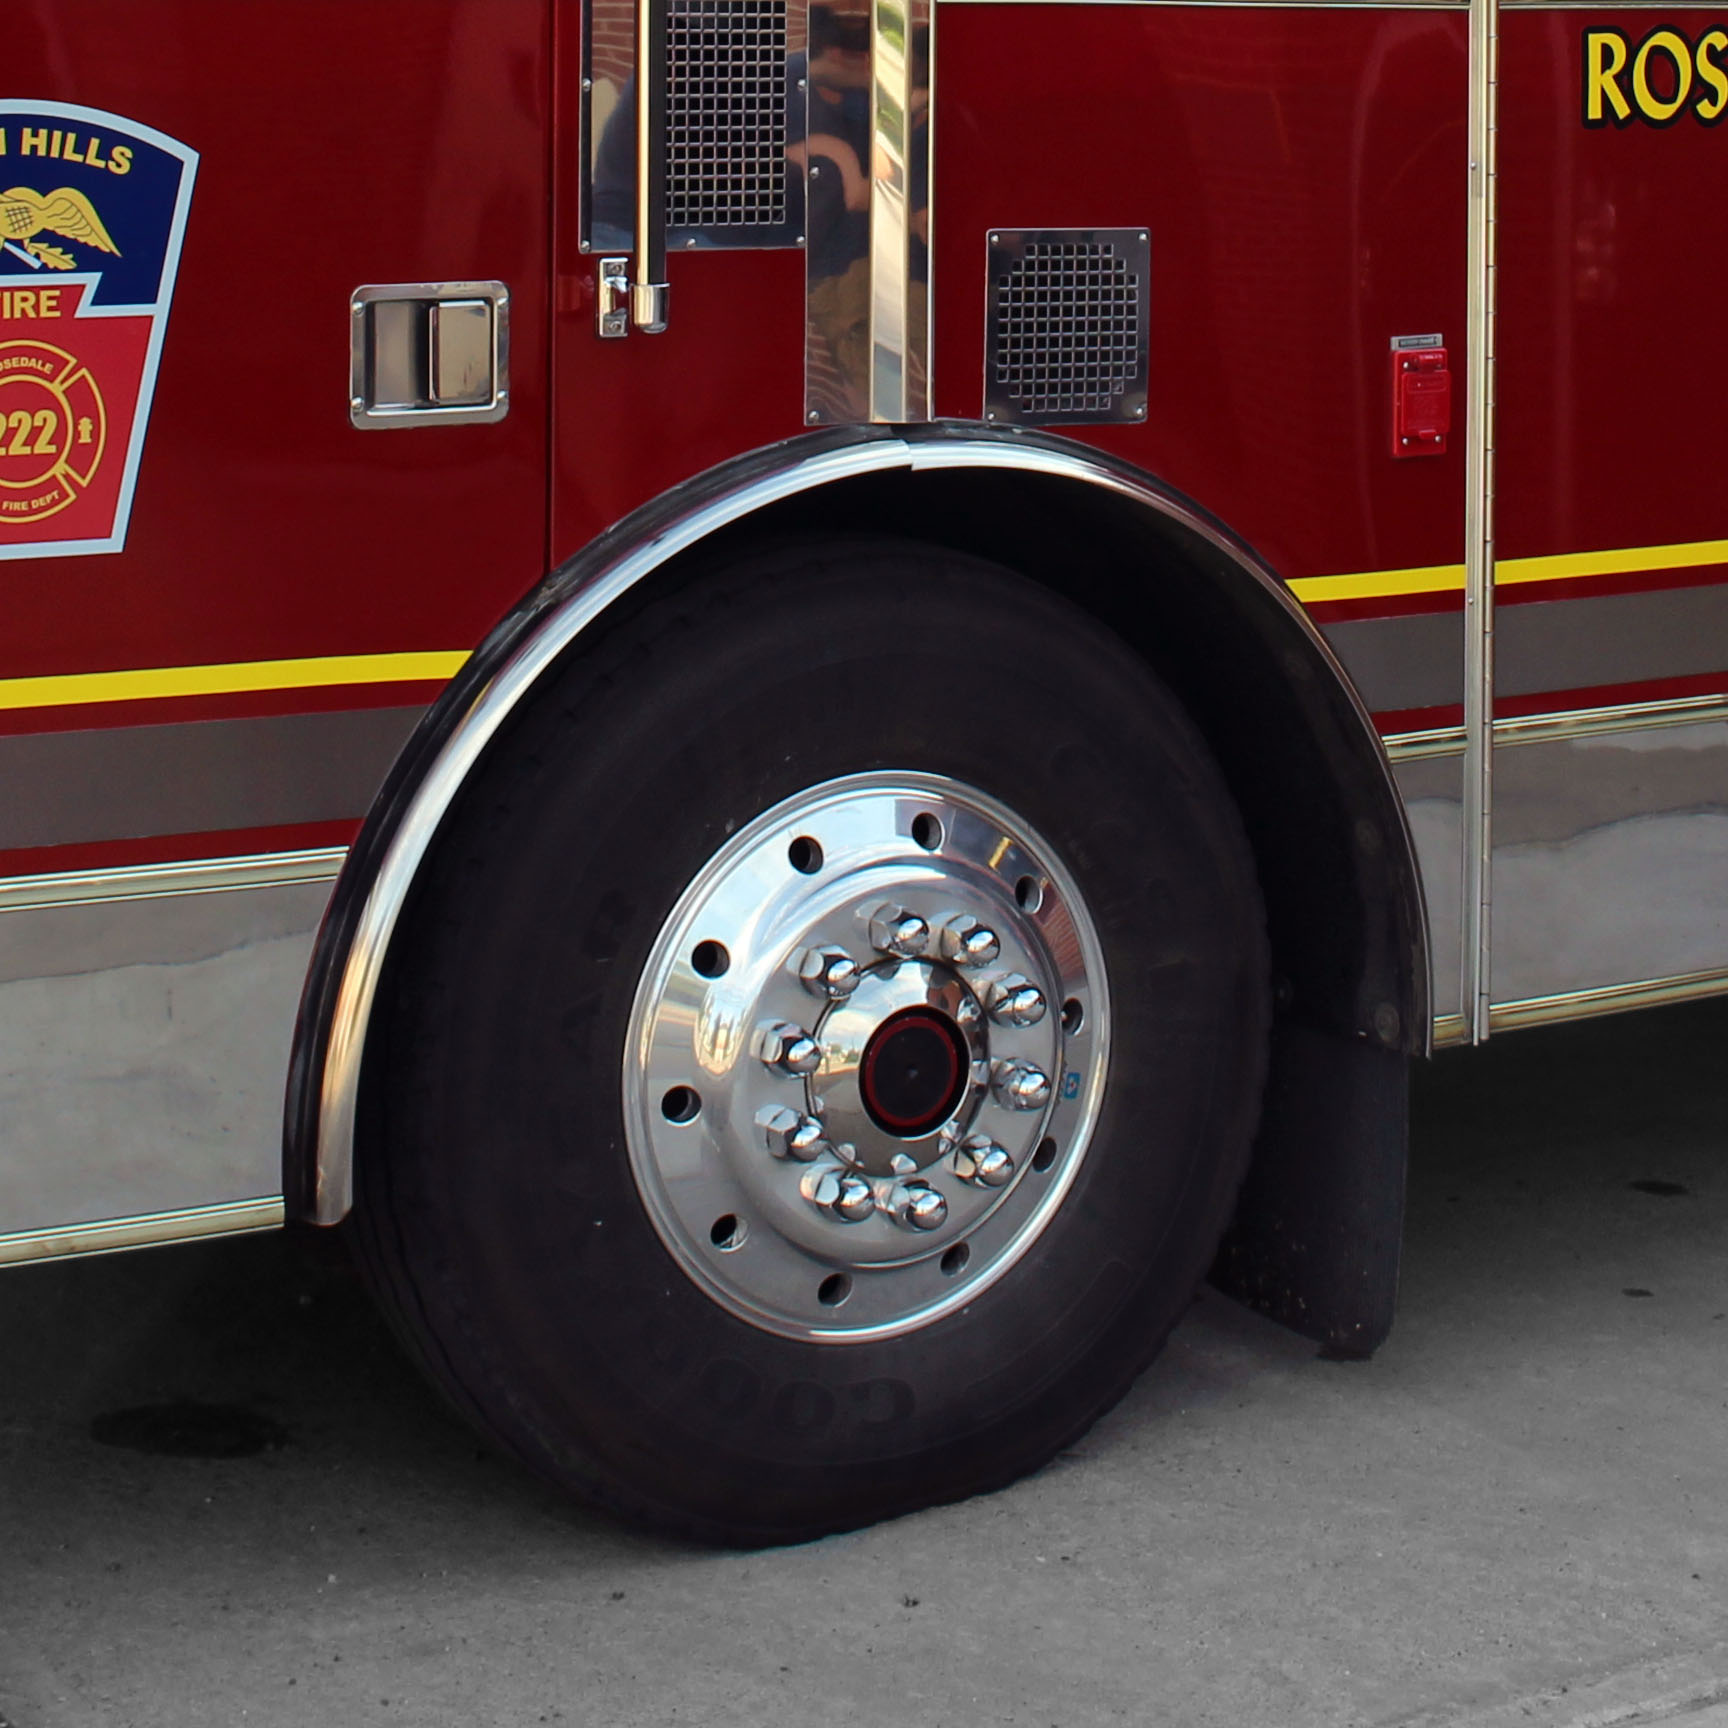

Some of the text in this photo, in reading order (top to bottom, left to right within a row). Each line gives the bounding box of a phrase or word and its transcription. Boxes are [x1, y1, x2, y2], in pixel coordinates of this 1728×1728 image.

[20, 127, 134, 175] HILLS
[2, 500, 29, 511] FIRE
[31, 489, 61, 509] DEPT
